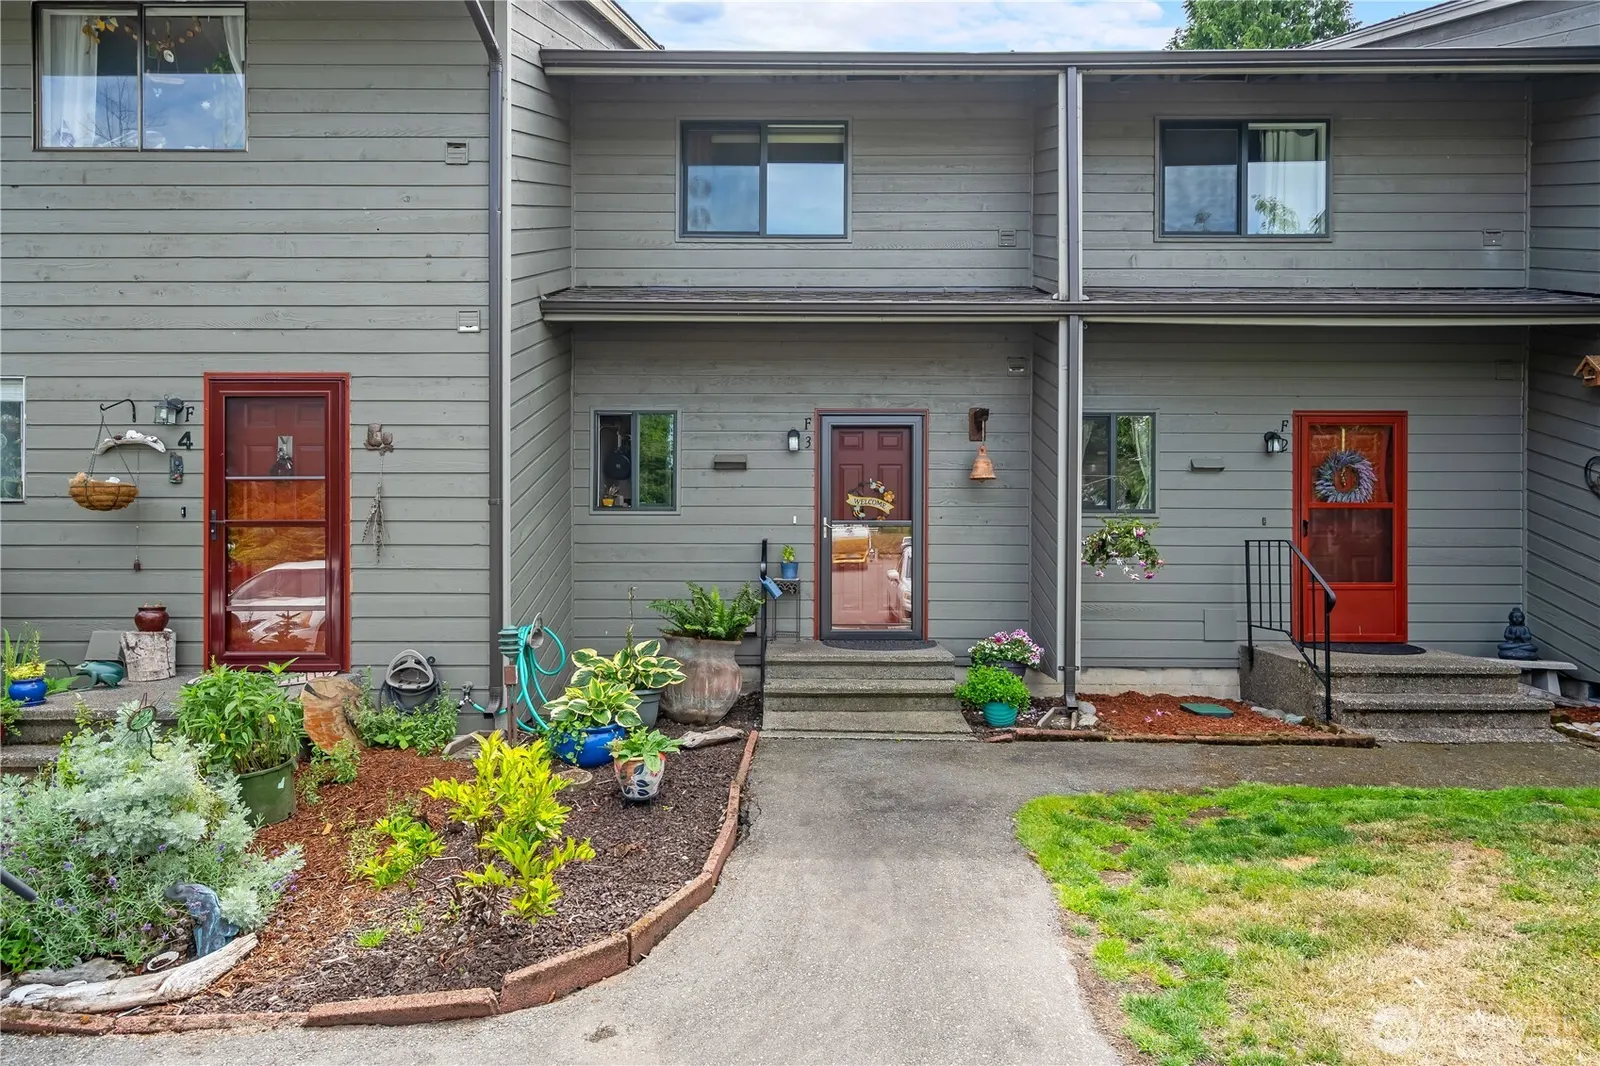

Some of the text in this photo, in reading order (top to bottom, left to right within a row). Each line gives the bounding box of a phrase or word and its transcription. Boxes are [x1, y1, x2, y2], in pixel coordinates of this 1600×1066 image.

[185, 406, 195, 423] F
[804, 417, 812, 430] F
[1280, 420, 1289, 433] F
[178, 431, 193, 450] 4
[804, 436, 812, 449] 3
[853, 498, 888, 509] WELCOME
